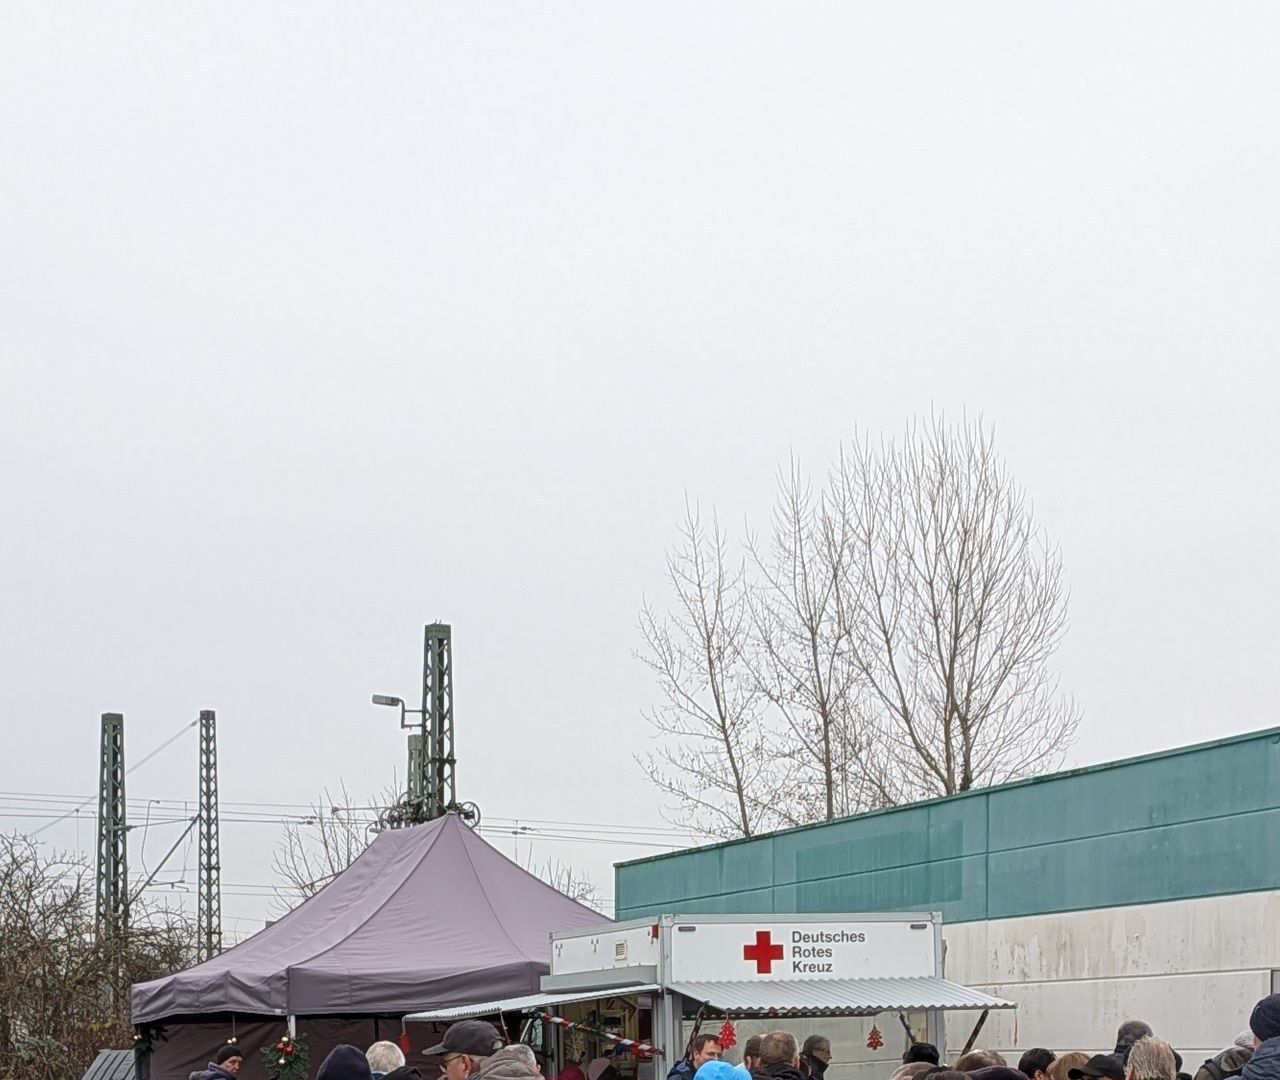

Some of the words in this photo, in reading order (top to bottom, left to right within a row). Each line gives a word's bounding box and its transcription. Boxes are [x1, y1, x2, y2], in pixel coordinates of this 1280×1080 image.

[792, 930, 866, 943] Deutsches
[792, 946, 833, 958] Rotes
[792, 961, 833, 973] Kreuz
